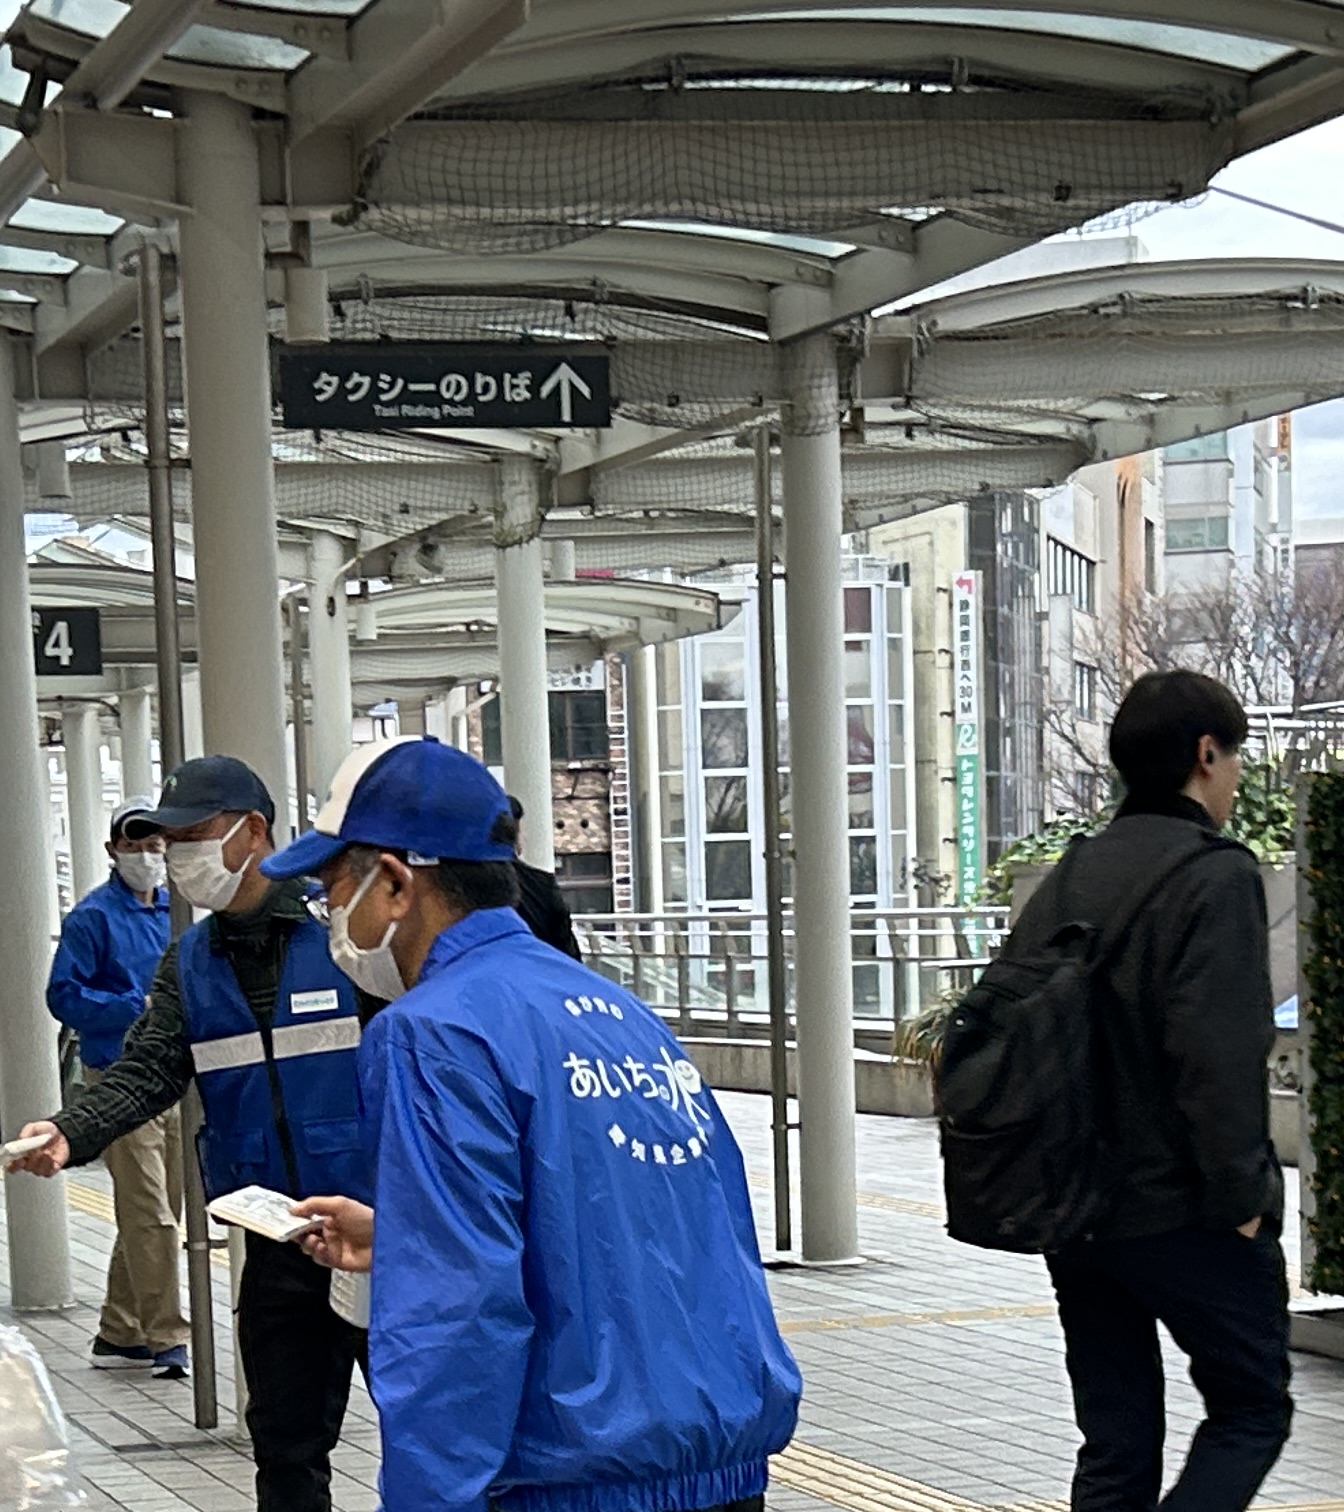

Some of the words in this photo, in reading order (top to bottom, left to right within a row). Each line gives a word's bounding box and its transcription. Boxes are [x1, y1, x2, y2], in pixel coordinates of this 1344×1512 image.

[312, 371, 533, 402] タクシーのりば
[44, 620, 73, 666] 4
